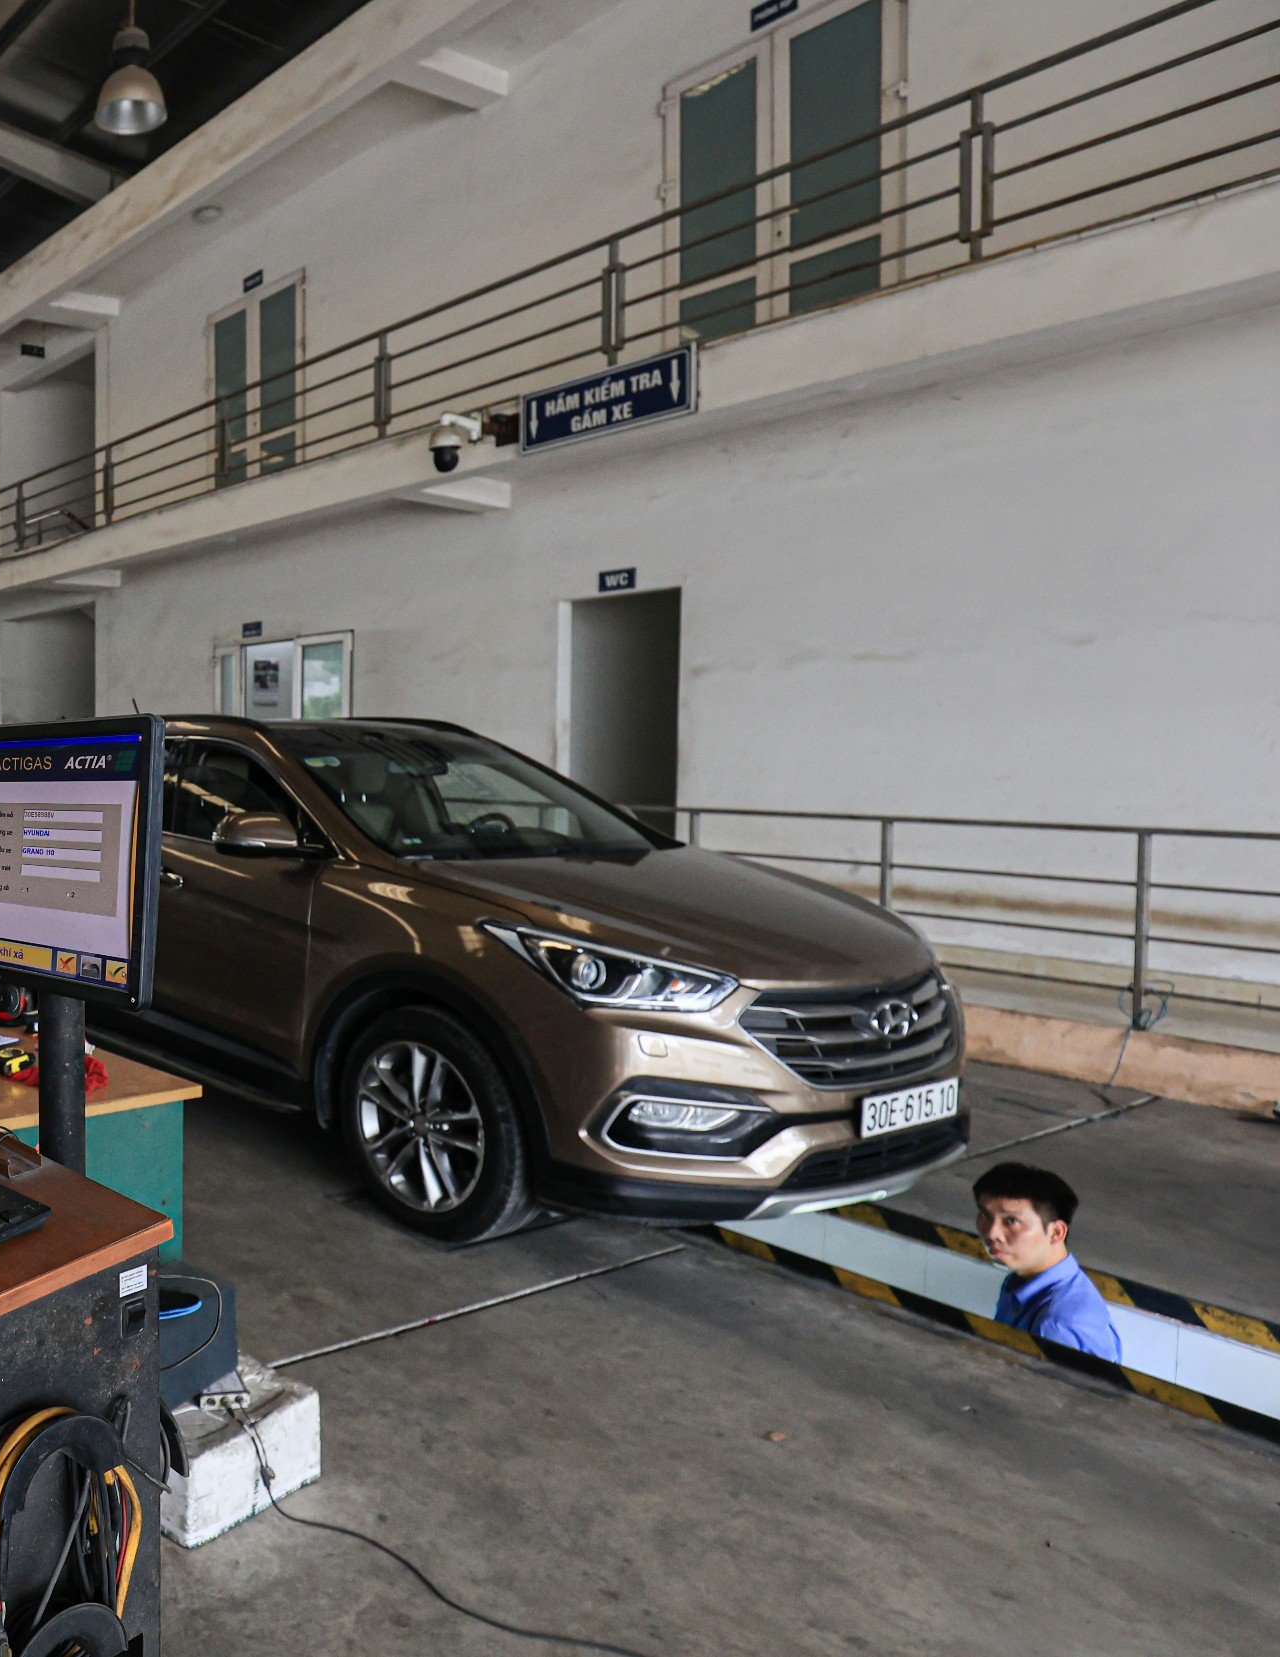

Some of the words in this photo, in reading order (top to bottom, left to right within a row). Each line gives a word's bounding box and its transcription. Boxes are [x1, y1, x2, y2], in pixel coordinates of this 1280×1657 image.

[630, 369, 662, 393] TRA
[611, 402, 633, 421] XE
[604, 572, 629, 587] WC
[23, 829, 50, 837] HYUNDAI
[22, 847, 44, 855] GRAND
[867, 1084, 955, 1131] 30E-615.10
